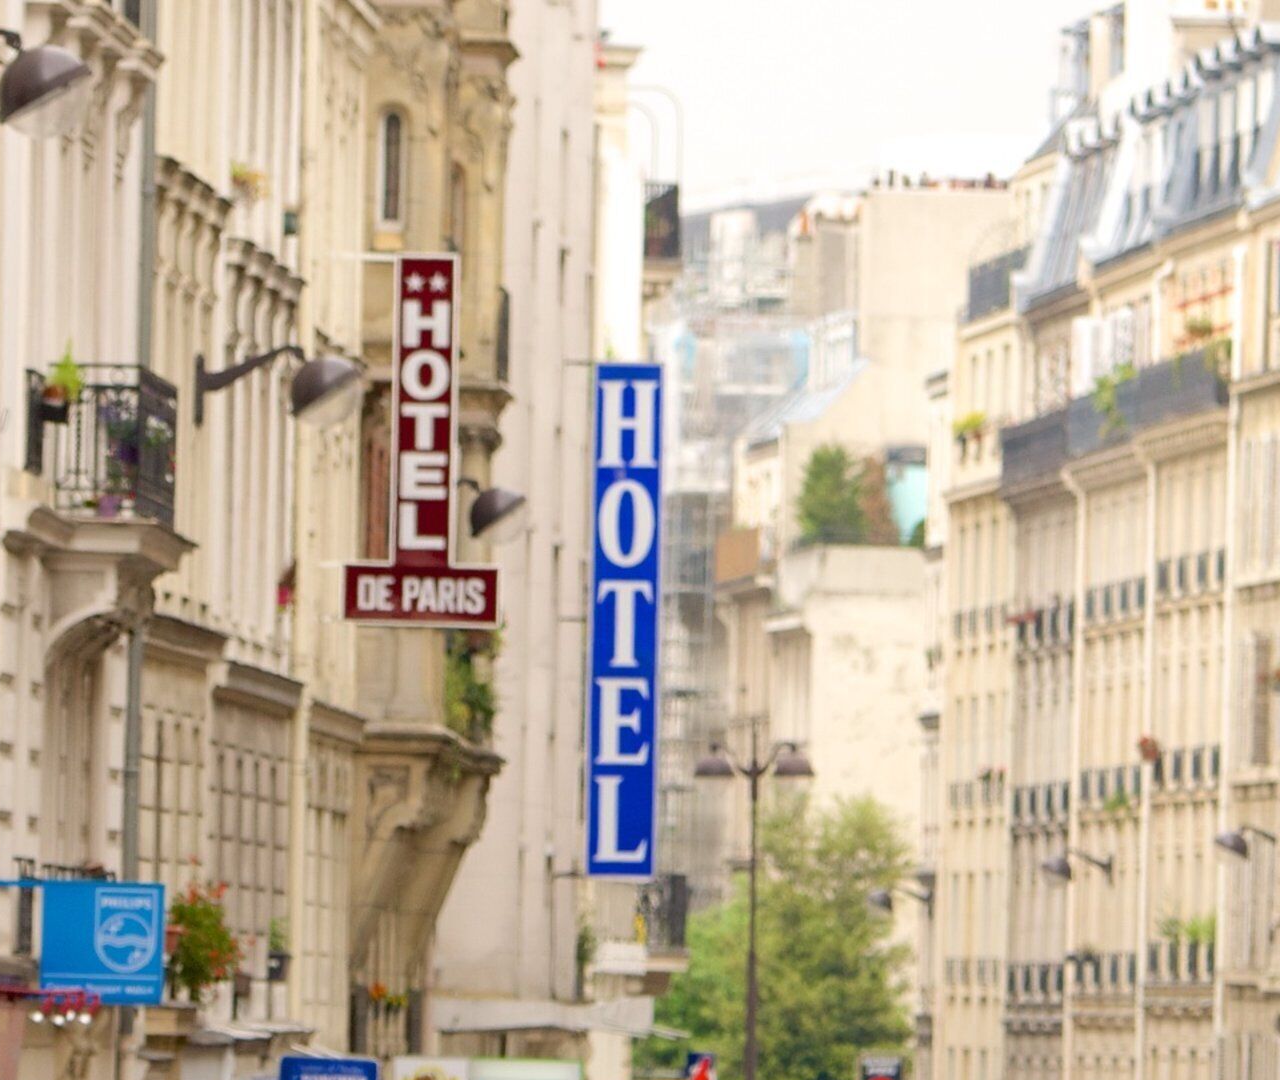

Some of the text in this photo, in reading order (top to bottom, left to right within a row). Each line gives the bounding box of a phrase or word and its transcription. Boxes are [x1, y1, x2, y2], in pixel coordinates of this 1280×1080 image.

[397, 301, 449, 551] HOTEL
[356, 575, 486, 615] DE PARIS
[592, 380, 658, 864] HOTEL
